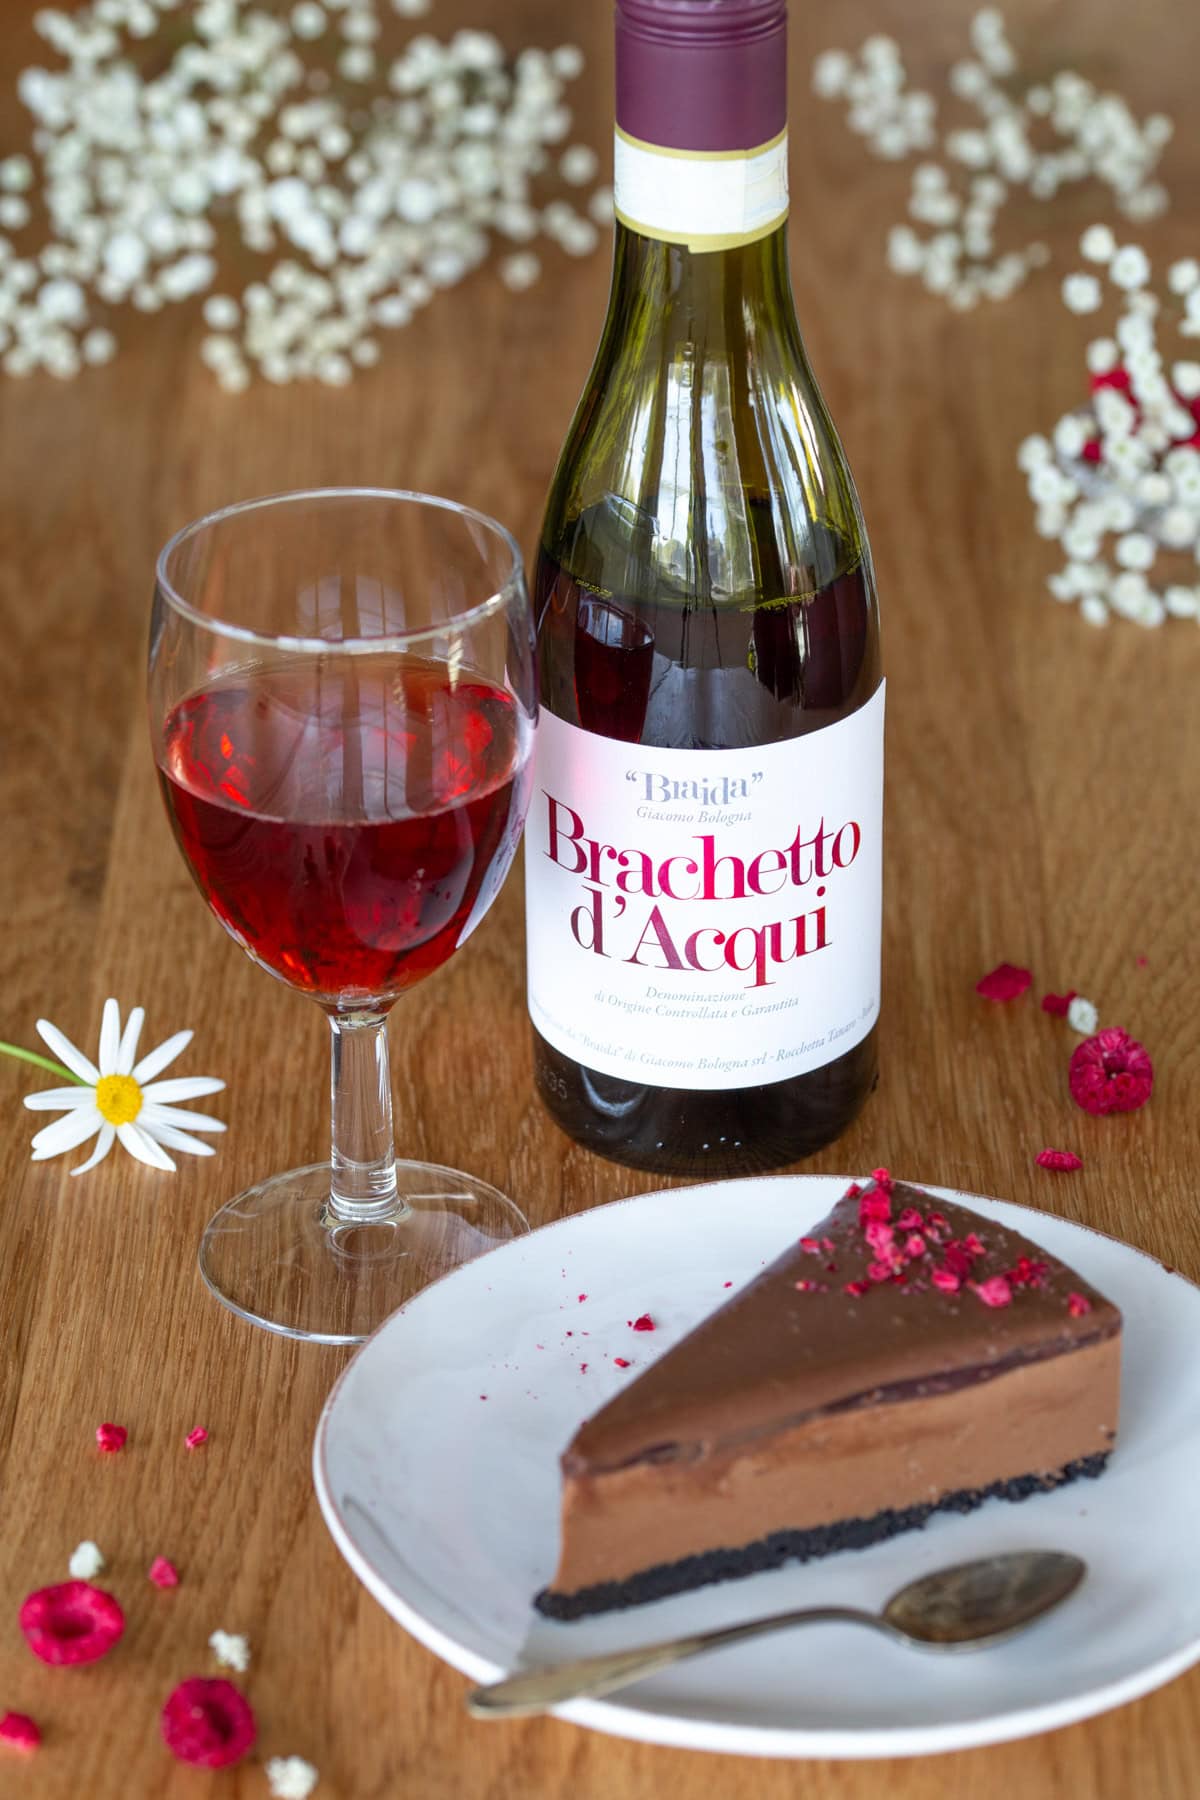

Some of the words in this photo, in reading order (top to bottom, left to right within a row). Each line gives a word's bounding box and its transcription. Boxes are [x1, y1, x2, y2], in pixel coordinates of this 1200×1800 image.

[636, 806, 694, 823] Giacomo
[698, 810, 752, 827] Bologna
[542, 788, 861, 901] Brachetto
[570, 884, 833, 989] d’Acqui
[645, 986, 746, 1002] Denominazione
[607, 994, 652, 1015] Origine
[655, 1004, 728, 1019] Controllata
[731, 1010, 738, 1018] e
[741, 997, 799, 1018] Garantita
[639, 1052, 694, 1070] Giacomo
[698, 1058, 748, 1072] Bologna
